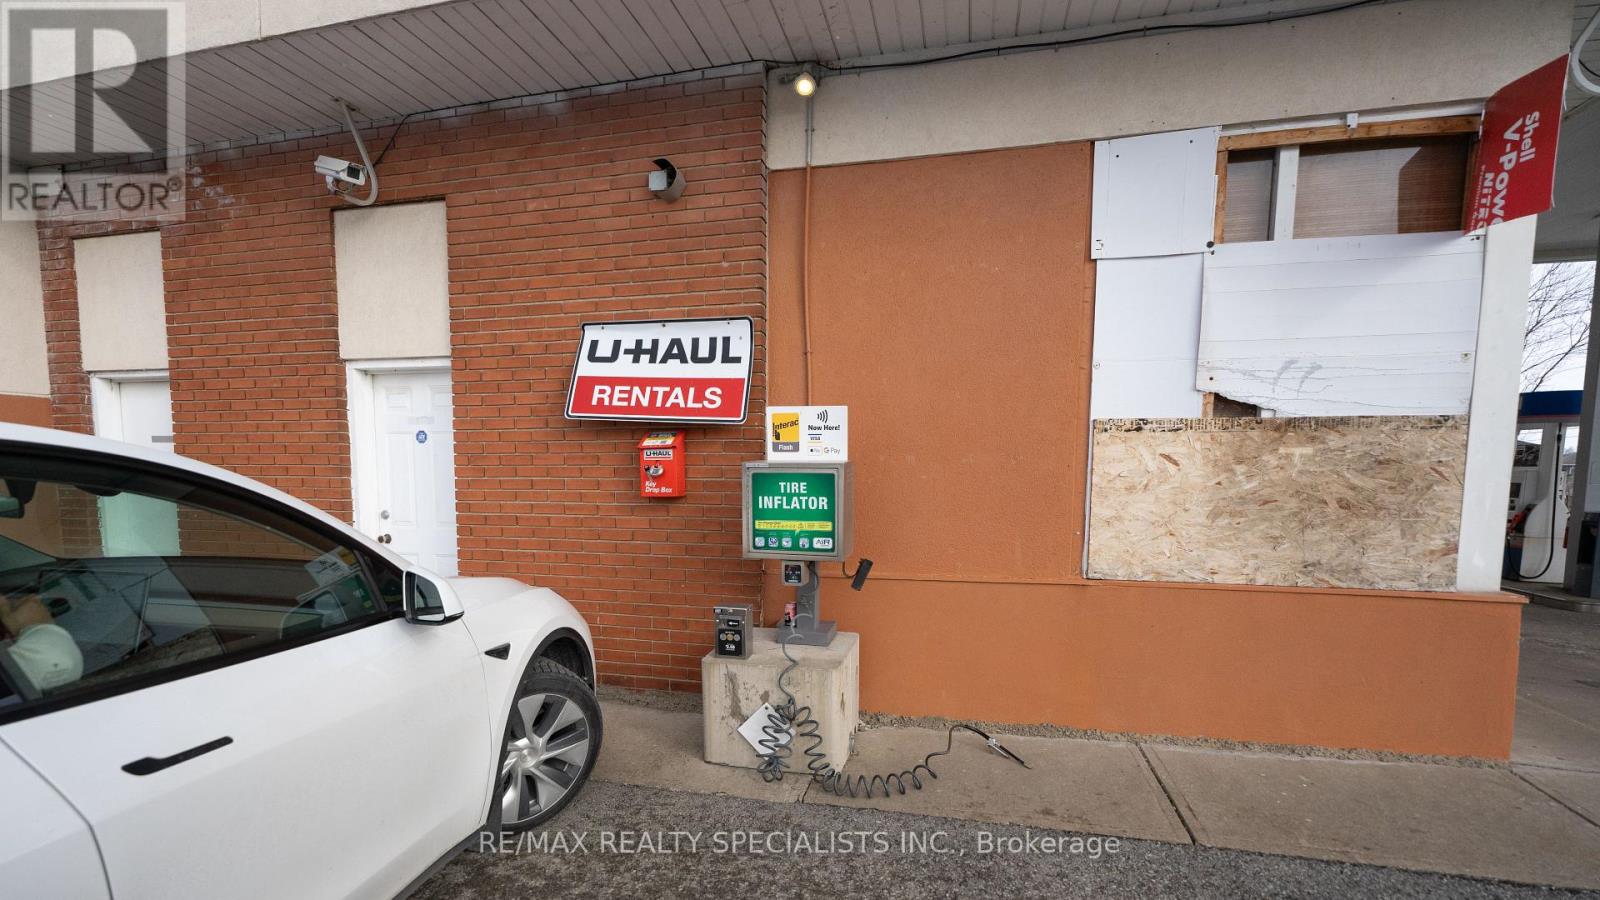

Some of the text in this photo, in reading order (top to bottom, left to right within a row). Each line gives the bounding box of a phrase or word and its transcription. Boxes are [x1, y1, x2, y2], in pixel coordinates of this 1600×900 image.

[1520, 111, 1540, 163] Shell
[587, 336, 742, 365] U-HAUL
[591, 385, 723, 409] RENTALS
[772, 419, 799, 433] Interac
[778, 482, 808, 494] TIRE
[758, 496, 829, 510] INFLATOR
